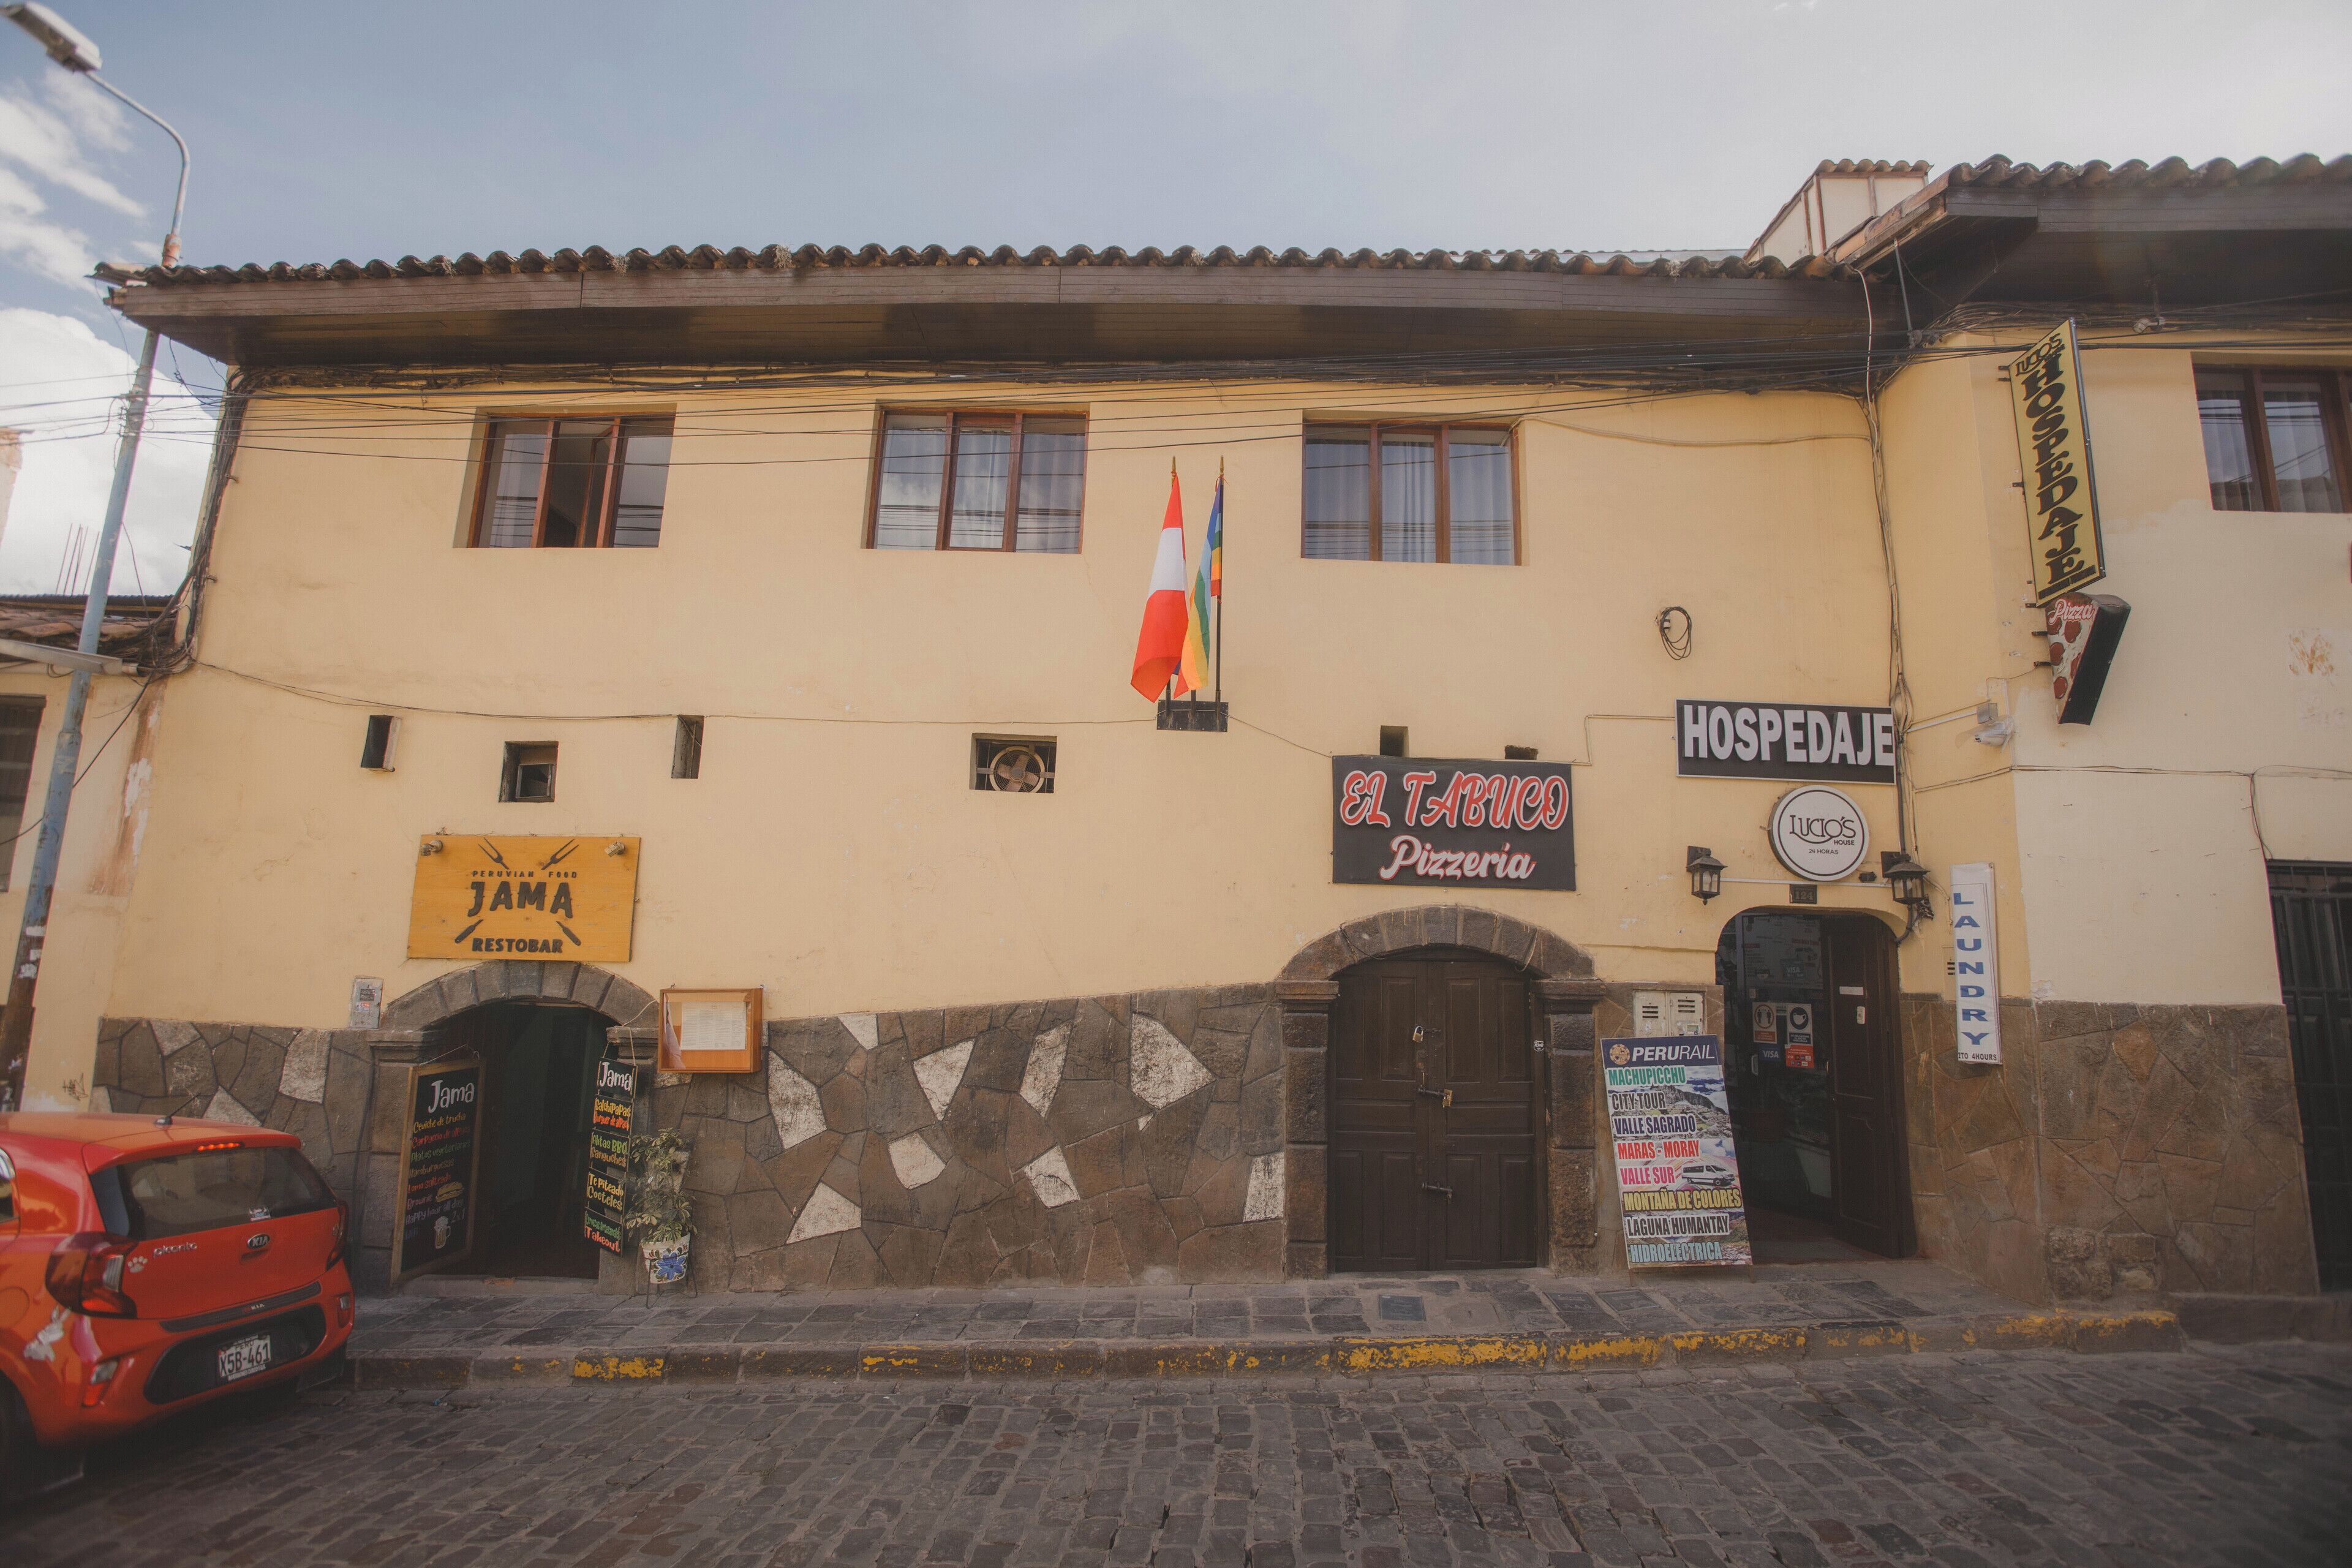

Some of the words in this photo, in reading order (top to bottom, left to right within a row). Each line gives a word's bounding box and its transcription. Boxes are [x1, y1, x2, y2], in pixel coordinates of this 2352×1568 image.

[2021, 353, 2084, 584] HOSPEDAJE
[2047, 598, 2095, 625] Pizza
[1684, 704, 1895, 766] HOSPEDAJE
[1340, 770, 1391, 828] EL
[1403, 770, 1569, 831] TABUCO
[467, 881, 573, 919] JAMA
[472, 938, 563, 953] RESTOBAR
[1953, 893, 1990, 1046] LAUNDRY
[1632, 1044, 1715, 1061] PERURAIL
[1762, 1050, 1779, 1058] VISA
[599, 1061, 632, 1091] Jama
[1608, 1066, 1686, 1086] MACHUPICCHU
[428, 1080, 475, 1114] Jama
[1611, 1092, 1637, 1110] CITY
[1637, 1091, 1666, 1109] TOUR
[1614, 1117, 1643, 1135] VALLE
[1646, 1115, 1696, 1134] SAGRADO
[612, 1139, 628, 1155] BBQ
[1618, 1142, 1656, 1159] MARAS
[1663, 1140, 1700, 1158] MORAY
[589, 1173, 597, 1186] Te
[1620, 1167, 1651, 1185] VALLE
[1653, 1166, 1675, 1184] SUR
[587, 1186, 624, 1211] Cocteles
[1623, 1187, 1676, 1212] MONTAÑA
[1677, 1190, 1692, 1210] DE
[1693, 1188, 1743, 1210] COLORES
[1627, 1217, 1670, 1237] LAGUNA
[1671, 1215, 1729, 1235] HUMANTAY
[252, 1236, 268, 1247] KIA
[585, 1226, 620, 1253] Takeout
[1630, 1242, 1723, 1263] HIDROELECTRICA
[220, 1342, 271, 1376] X5B-461
